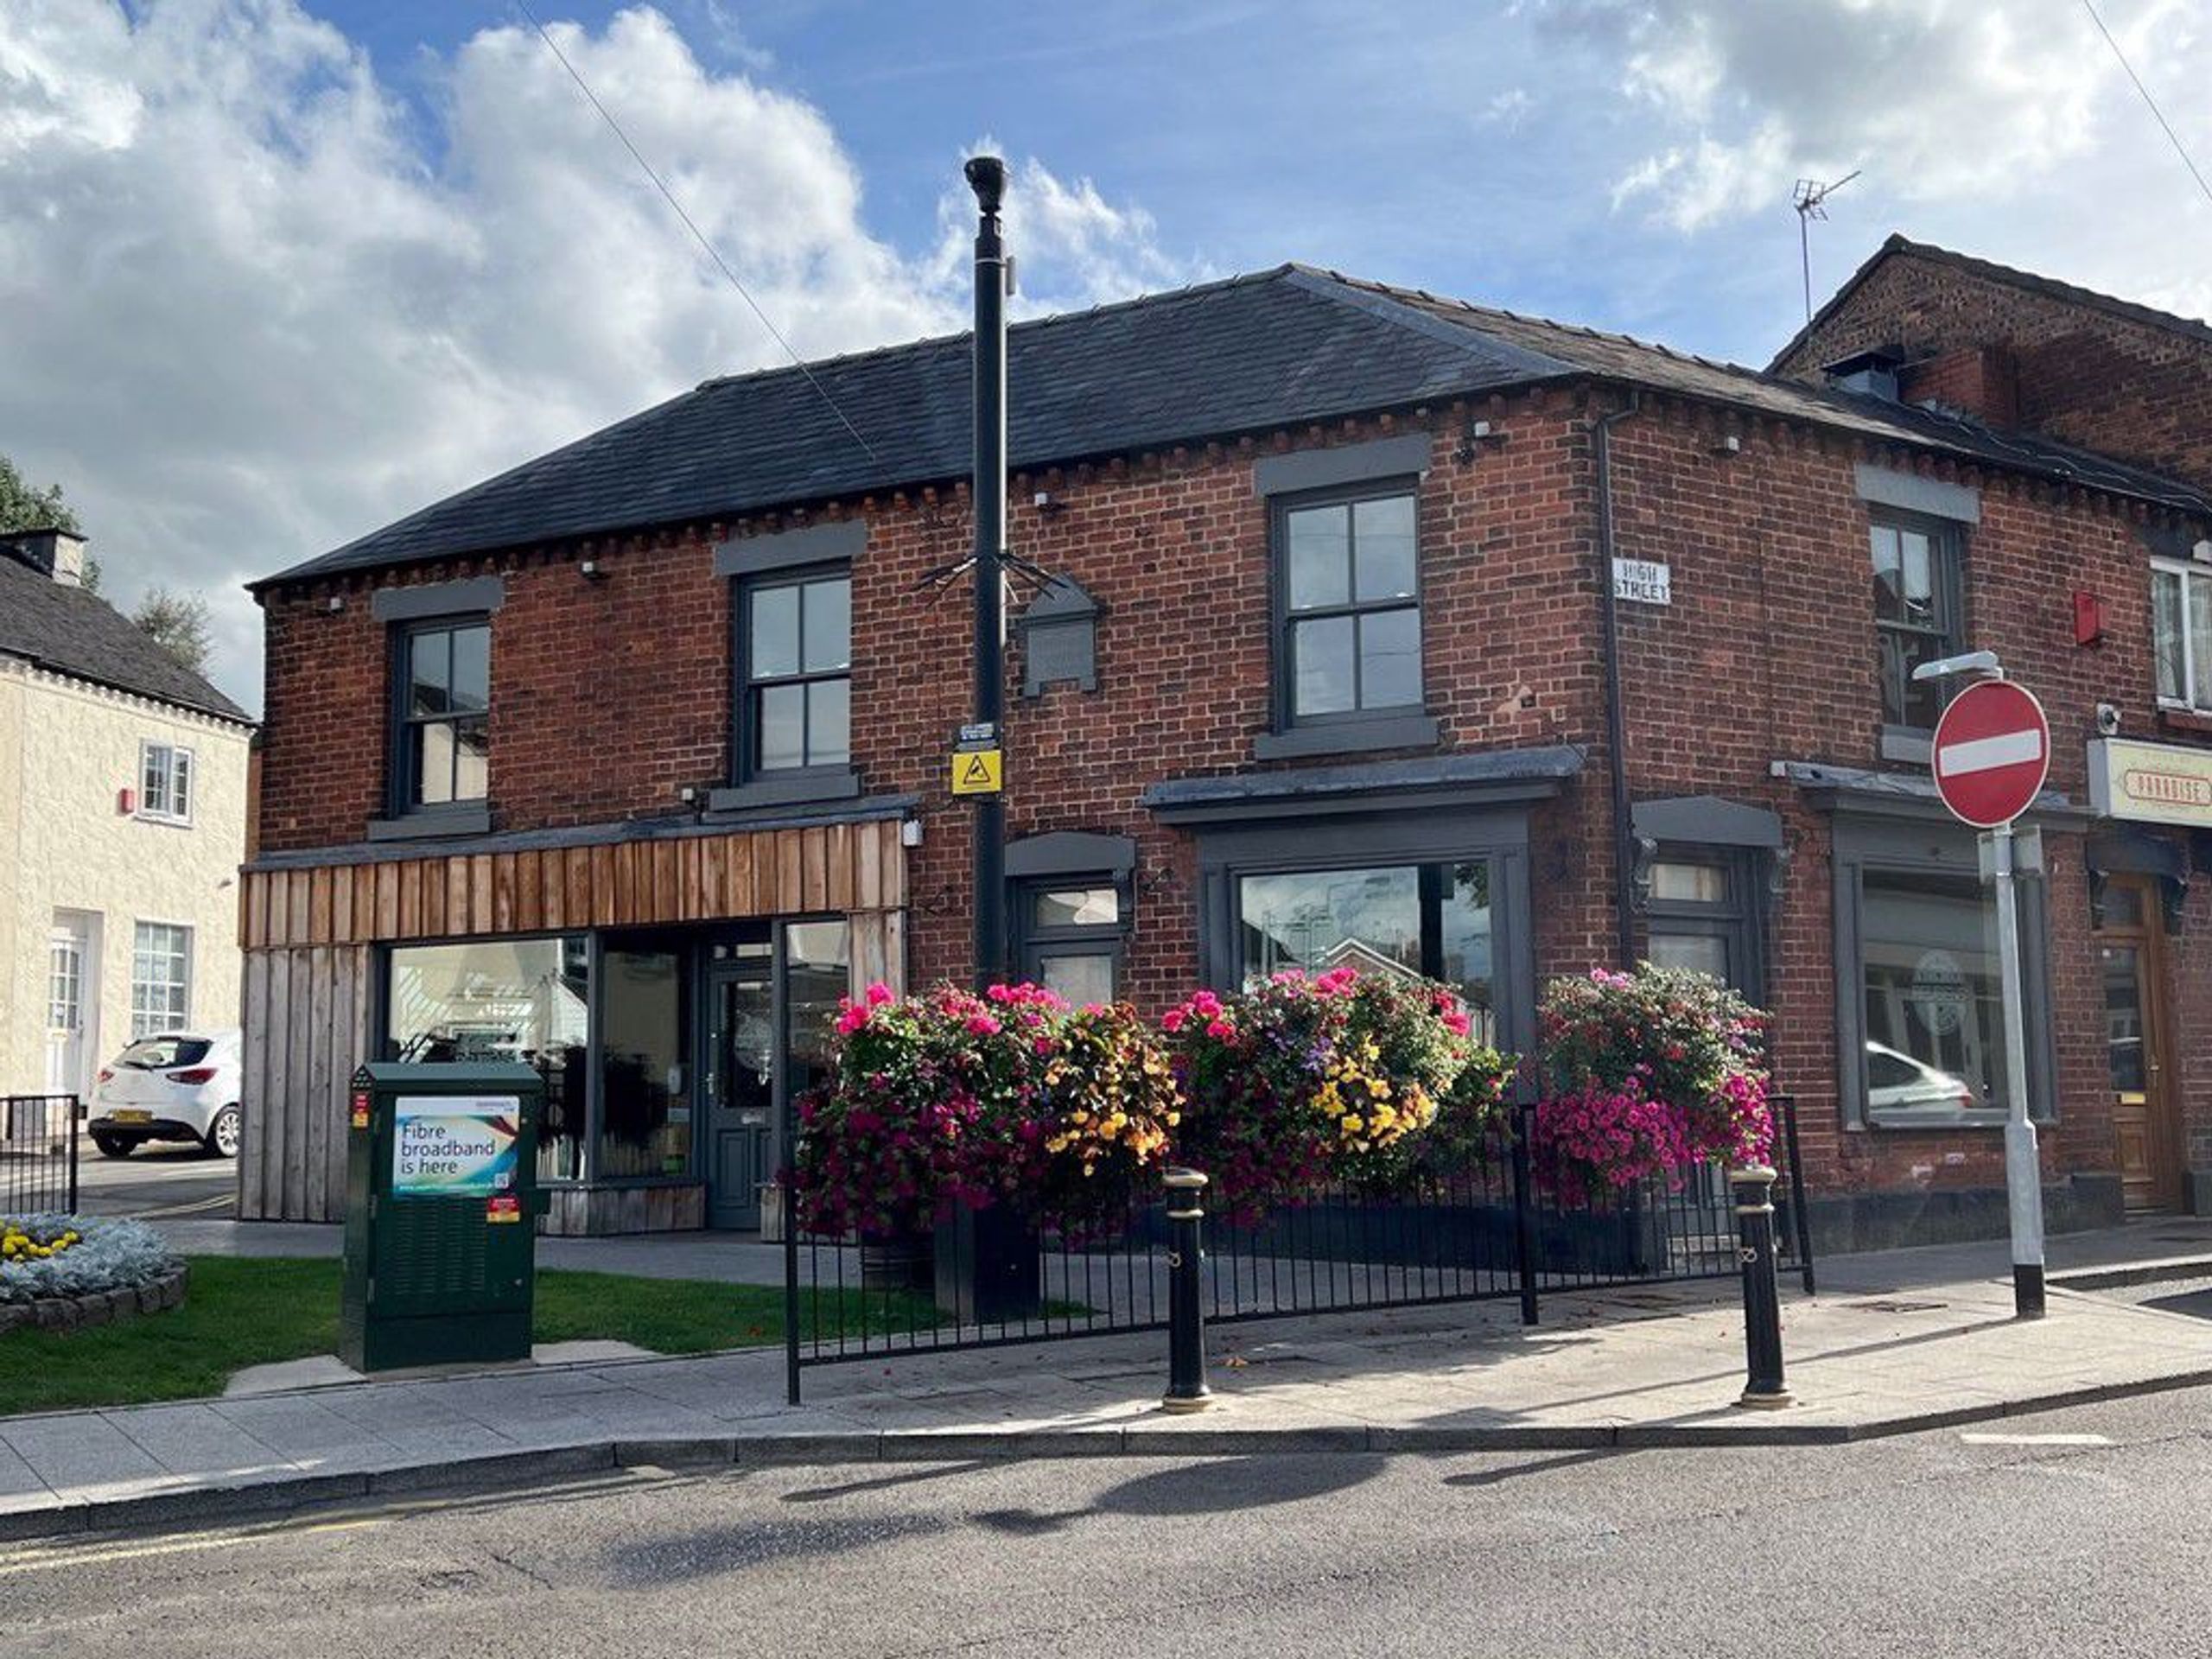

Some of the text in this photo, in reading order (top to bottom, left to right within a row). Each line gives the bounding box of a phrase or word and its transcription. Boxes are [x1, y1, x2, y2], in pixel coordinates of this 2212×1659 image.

[1614, 580, 1668, 600] STREET
[401, 1123, 446, 1139] Fibre
[401, 1140, 496, 1157] broadband
[401, 1158, 459, 1174] is here
